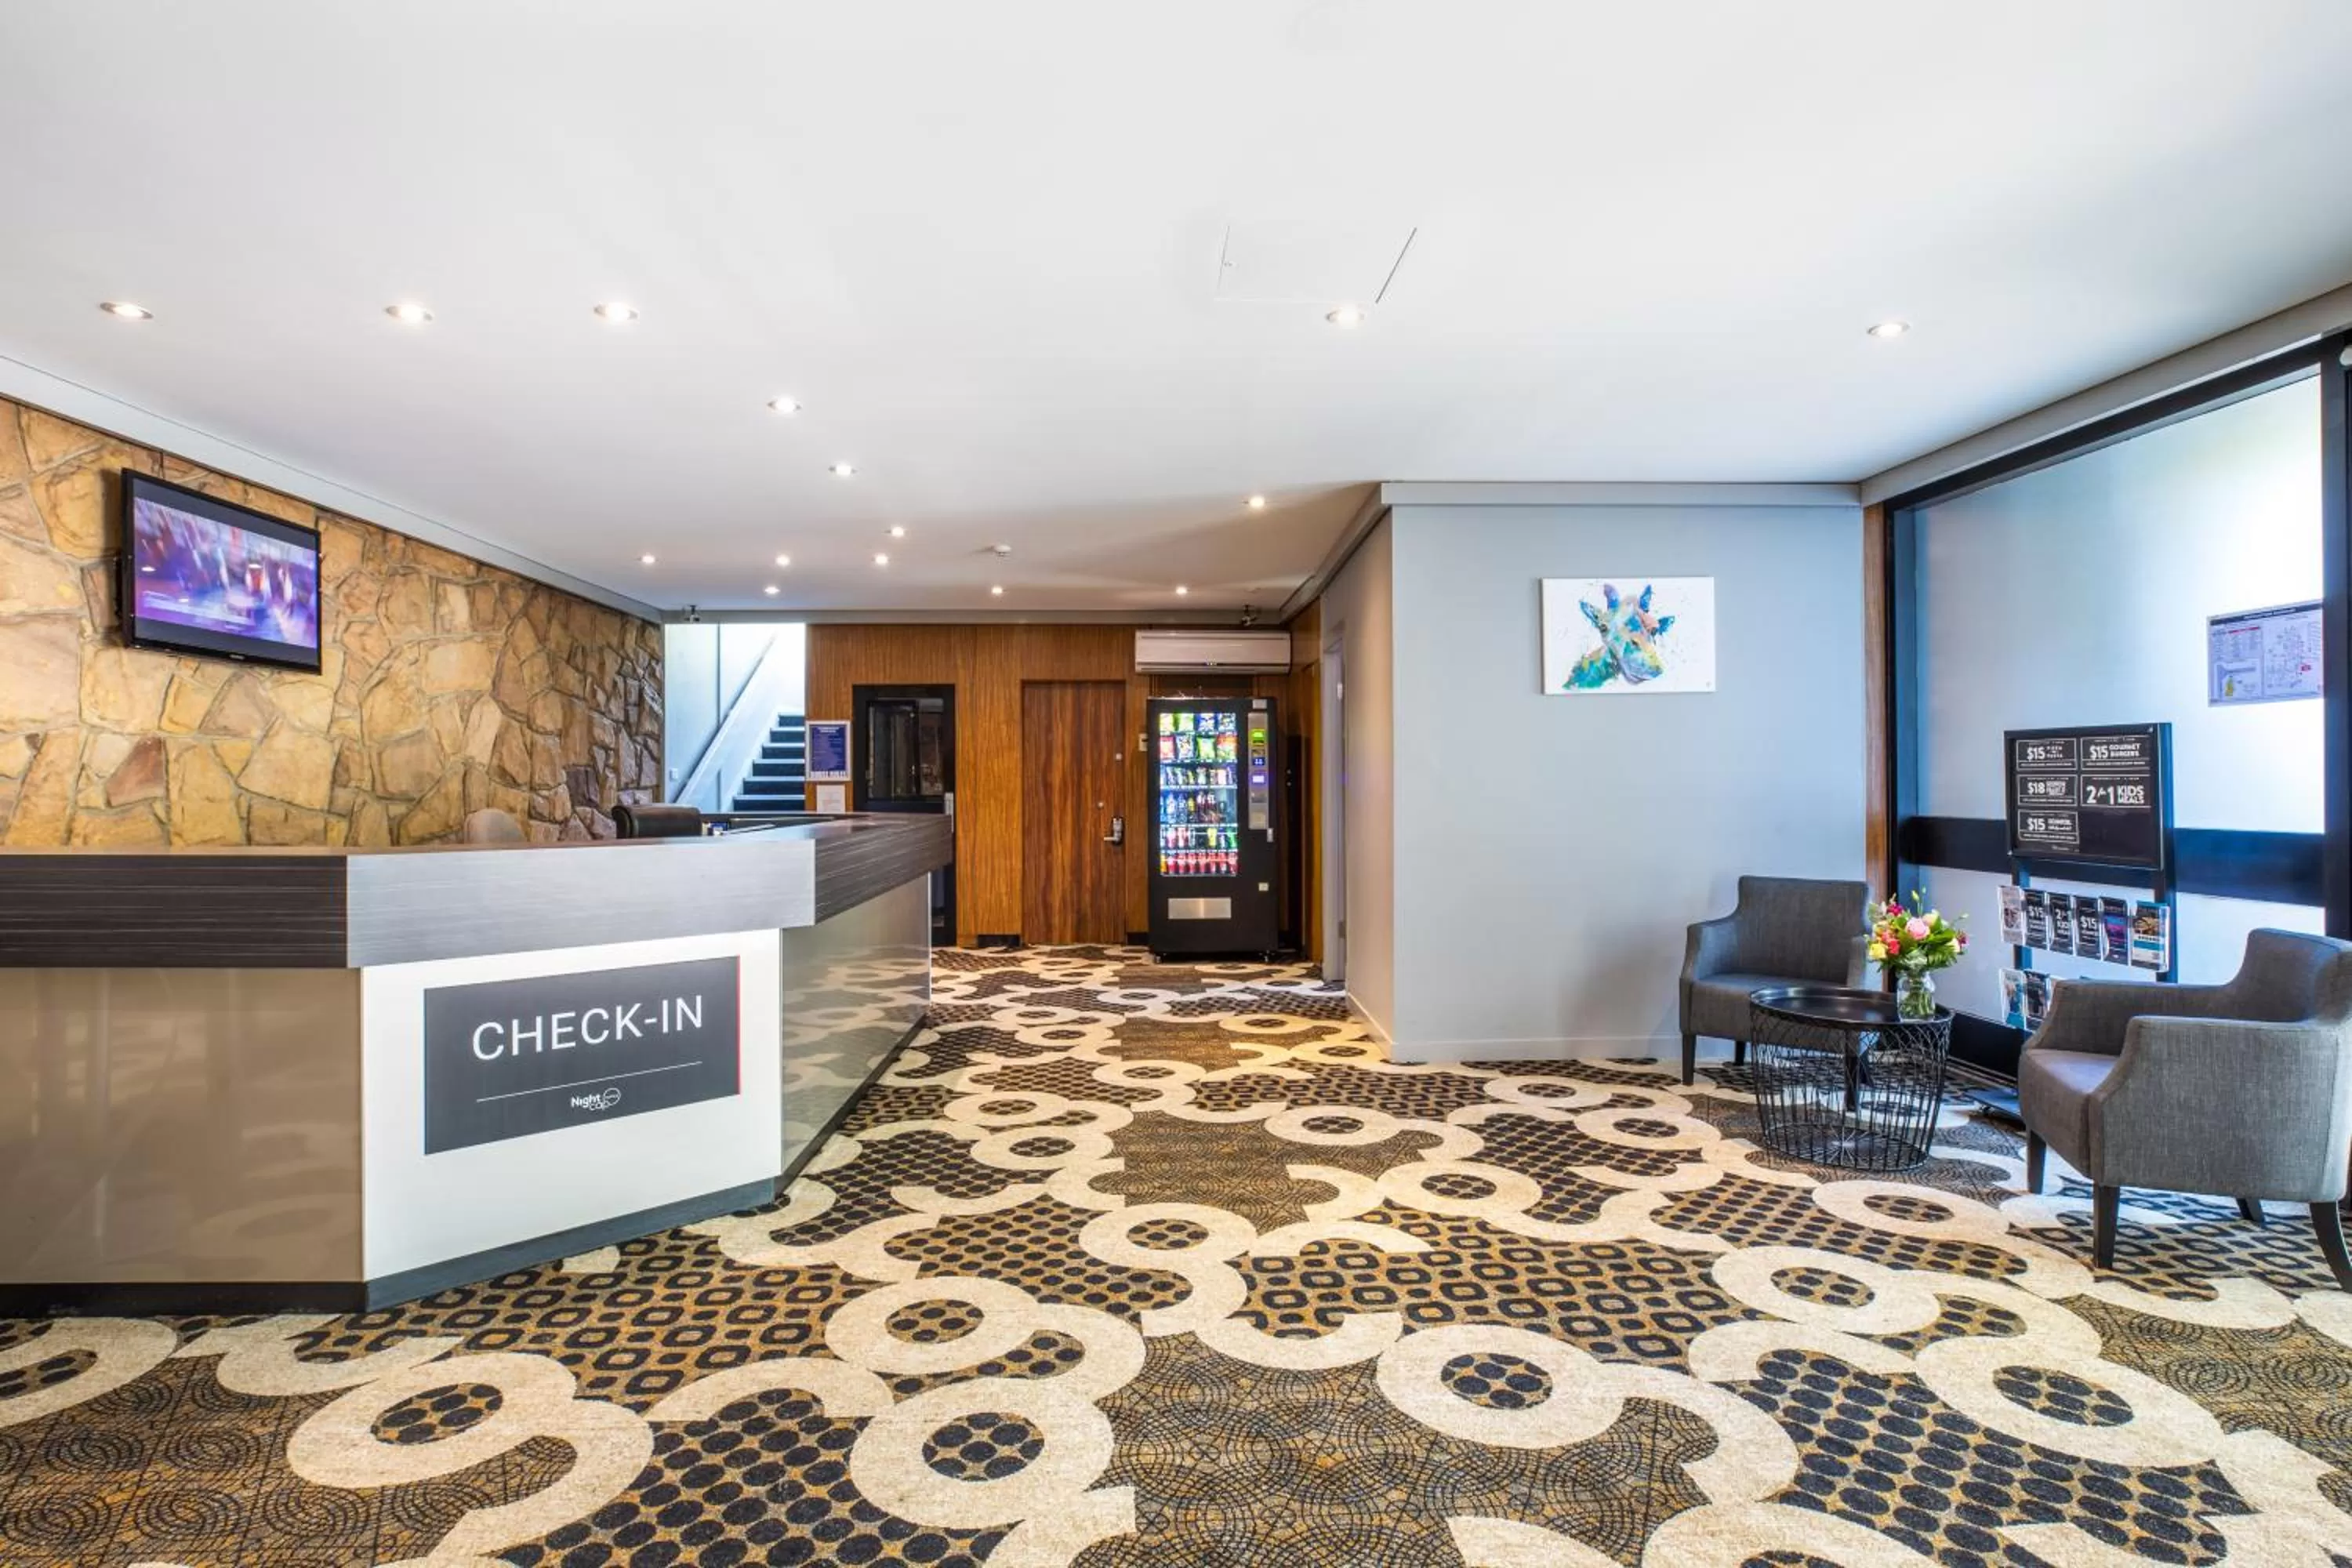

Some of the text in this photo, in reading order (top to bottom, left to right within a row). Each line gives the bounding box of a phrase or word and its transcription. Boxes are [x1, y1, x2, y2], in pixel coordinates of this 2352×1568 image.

[2027, 746, 2045, 762] $15
[2089, 745, 2108, 760] $15
[2027, 782, 2045, 795] $18
[2086, 786, 2097, 804] 2
[2107, 786, 2114, 804] 1
[2118, 785, 2144, 796] KIDS
[2027, 818, 2045, 831] $15
[2081, 916, 2097, 929] $15
[472, 995, 703, 1061] CHECK-IN
[571, 1094, 600, 1109] Night
[590, 1101, 609, 1111] cap
